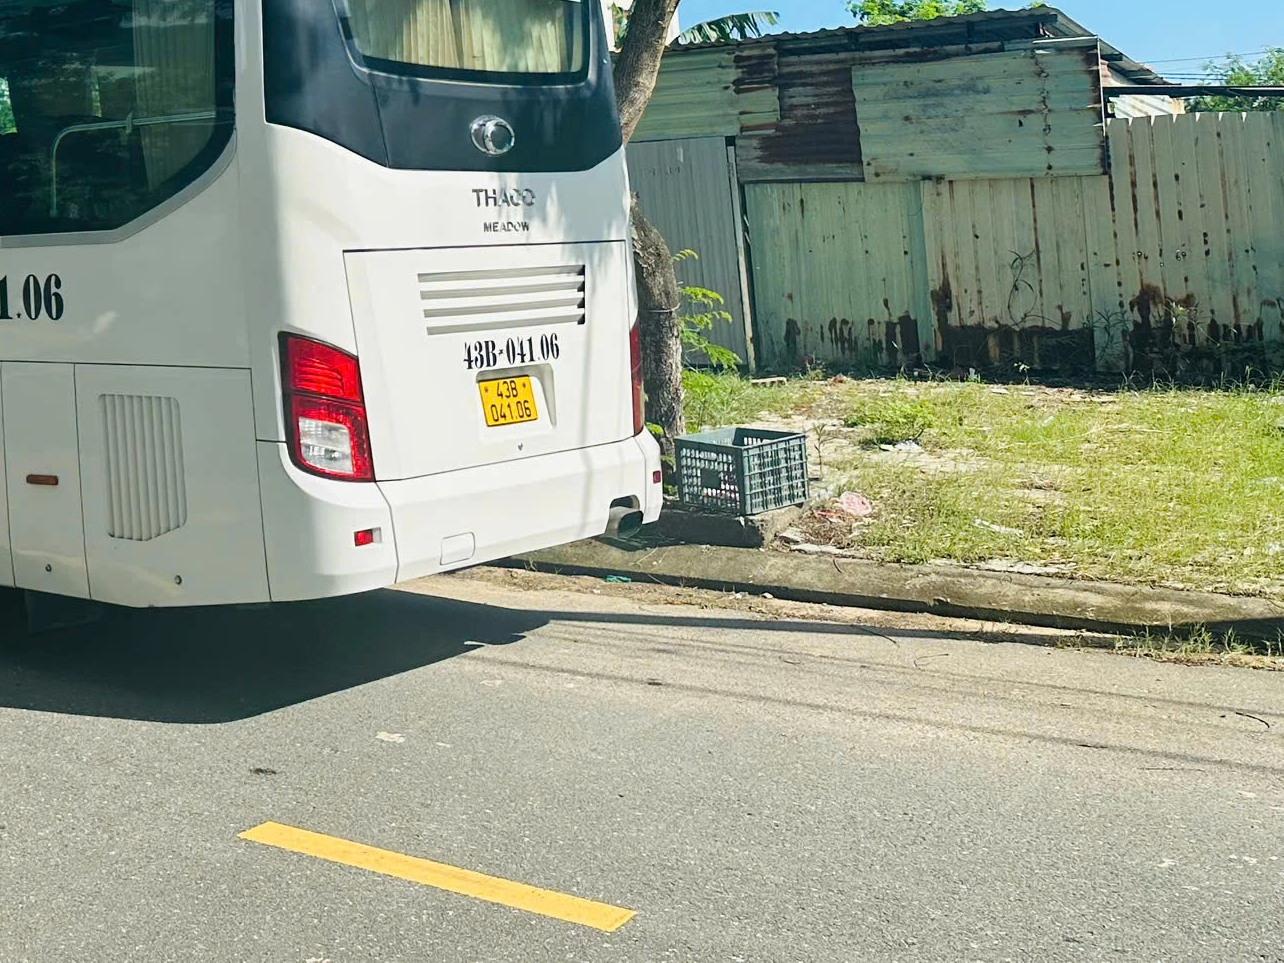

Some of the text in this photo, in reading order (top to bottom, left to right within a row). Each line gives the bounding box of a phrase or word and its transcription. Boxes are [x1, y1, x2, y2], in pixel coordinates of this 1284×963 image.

[472, 188, 536, 207] THACO
[483, 221, 530, 233] MEADOW
[496, 380, 519, 399] 43B
[490, 400, 532, 422] 041.06
